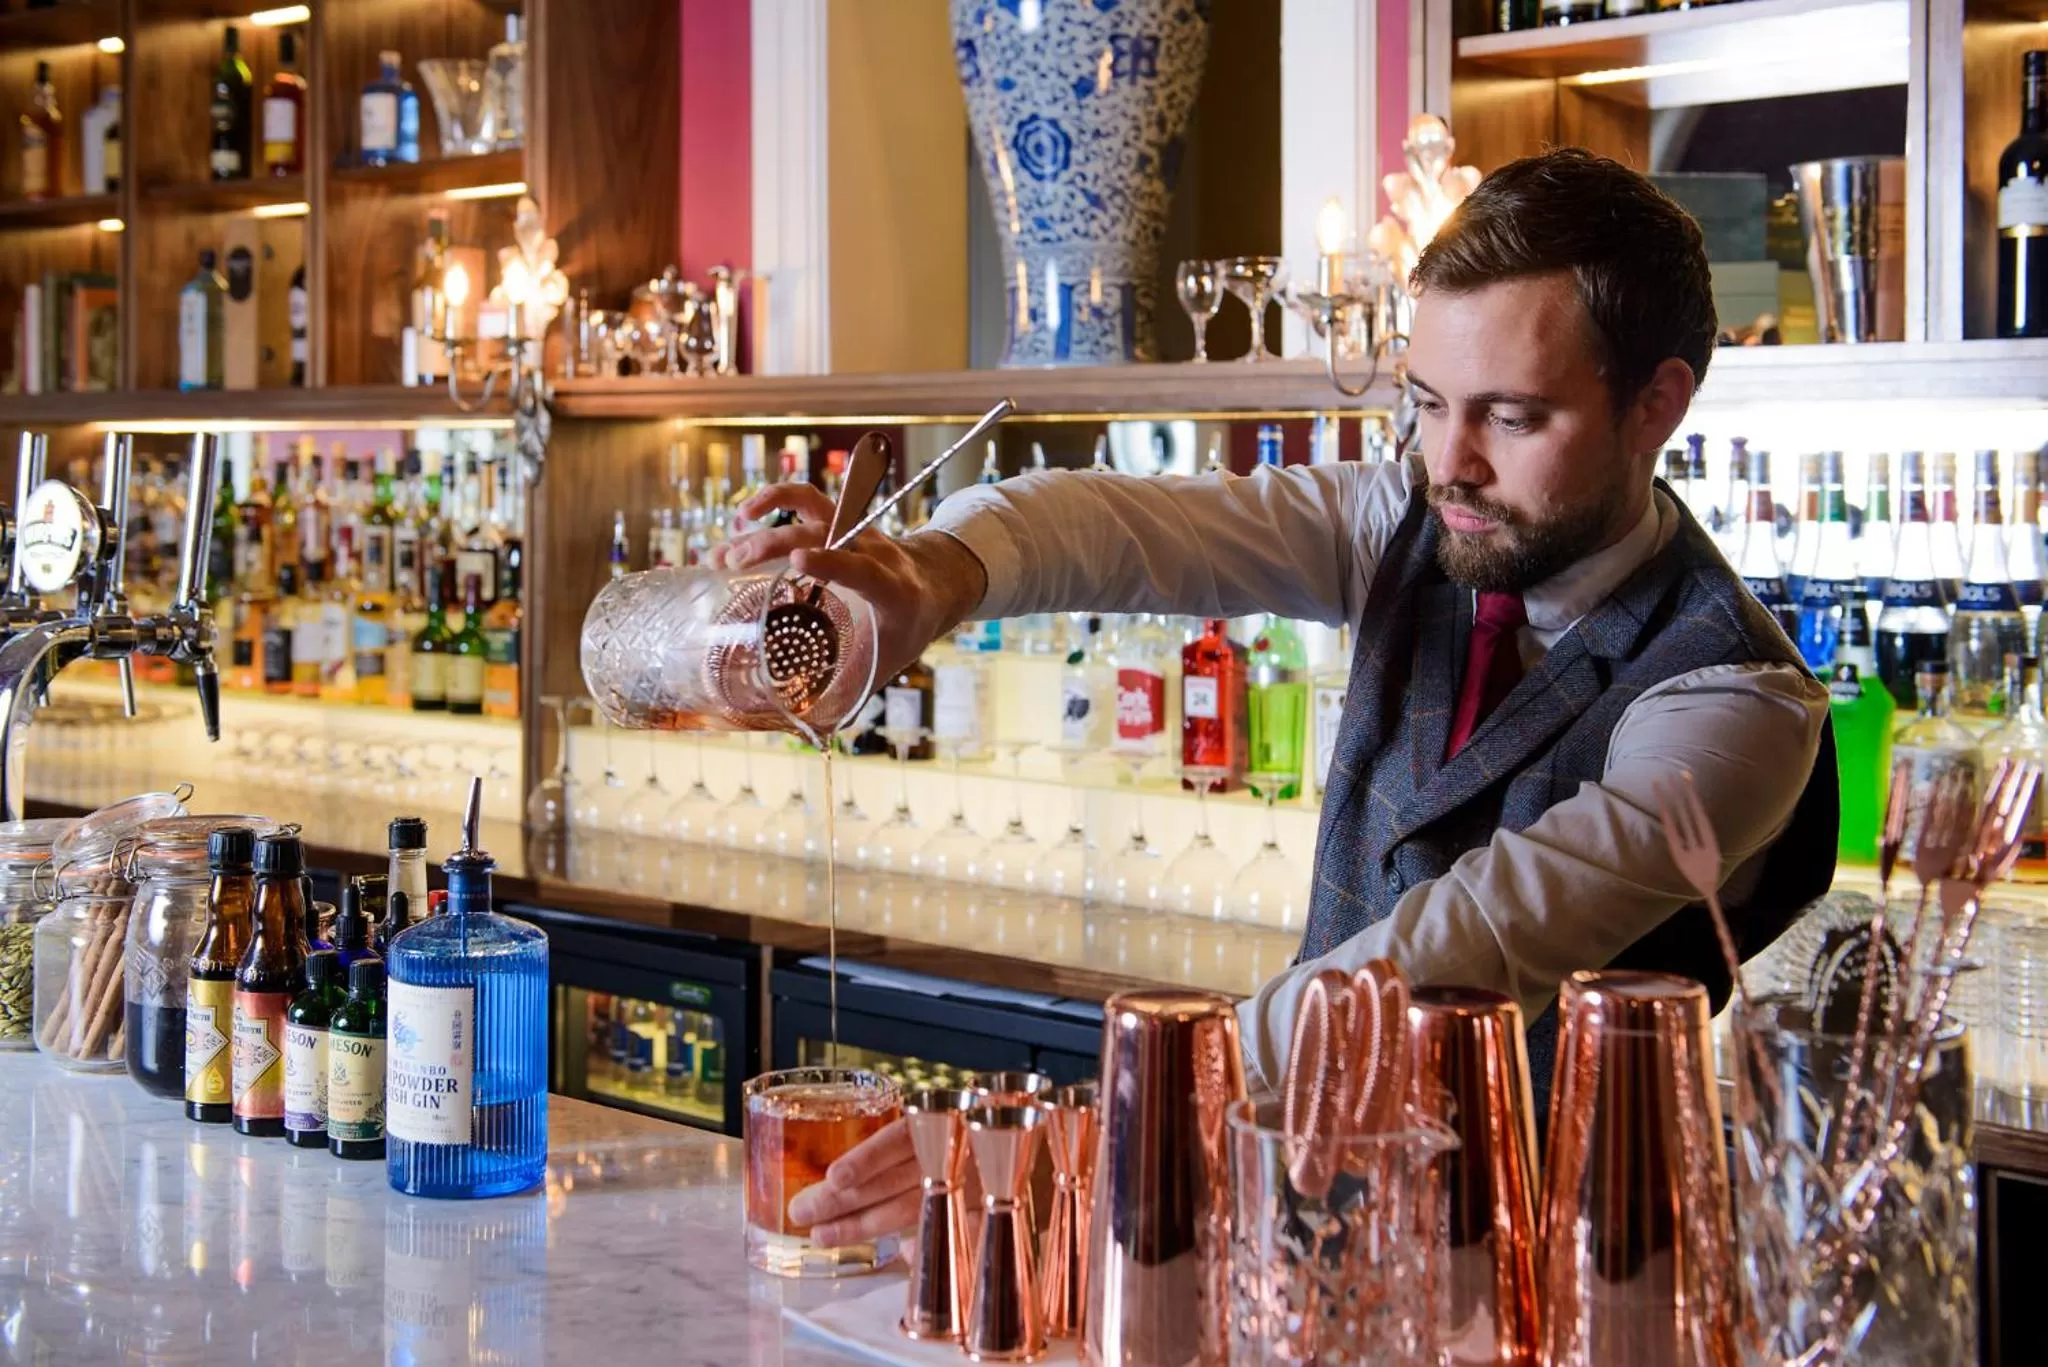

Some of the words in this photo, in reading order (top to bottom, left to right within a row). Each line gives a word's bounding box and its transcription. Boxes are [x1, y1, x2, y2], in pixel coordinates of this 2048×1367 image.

[1886, 582, 1932, 599] BOLS
[1959, 584, 2001, 602] BOLS
[412, 1092, 441, 1110] GIN
